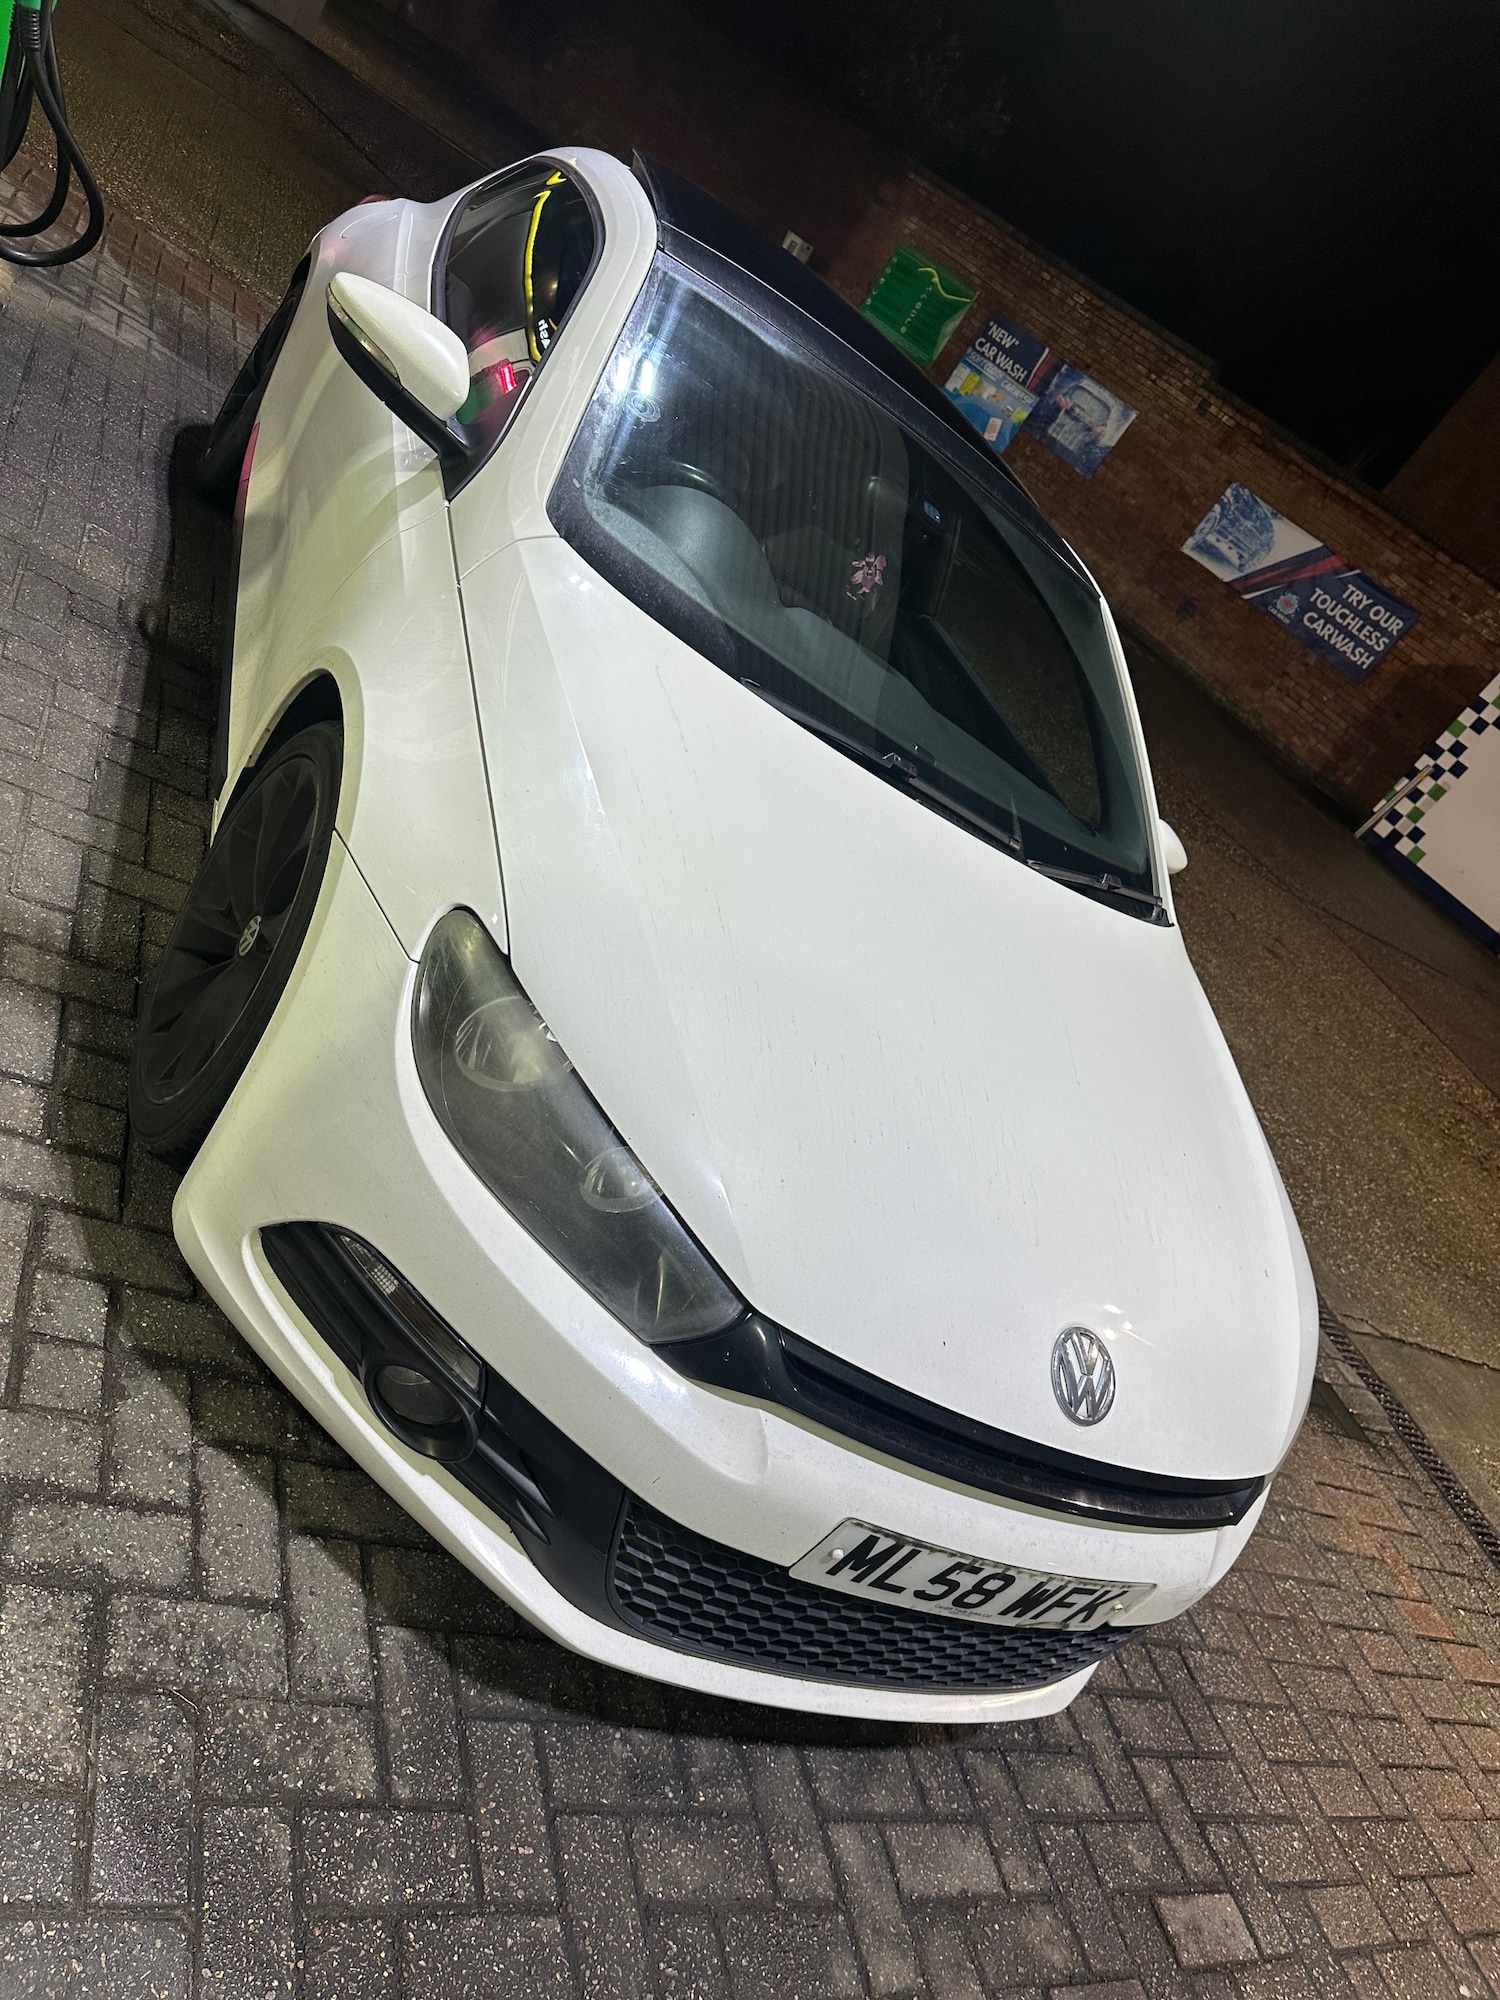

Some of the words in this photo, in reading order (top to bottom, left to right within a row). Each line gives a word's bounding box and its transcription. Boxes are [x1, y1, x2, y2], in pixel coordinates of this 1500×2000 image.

[969, 351, 985, 366] SOFT
[983, 359, 1005, 379] CLOTH
[975, 338, 997, 360] CAR
[996, 351, 1027, 382] WASH
[1309, 588, 1389, 652] TOUCHLESS
[1342, 584, 1373, 610] TRY
[1369, 606, 1403, 636] OUR
[1303, 612, 1374, 669] CARWASH
[825, 1535, 1016, 1609] ML58
[998, 1578, 1129, 1624] WFK
